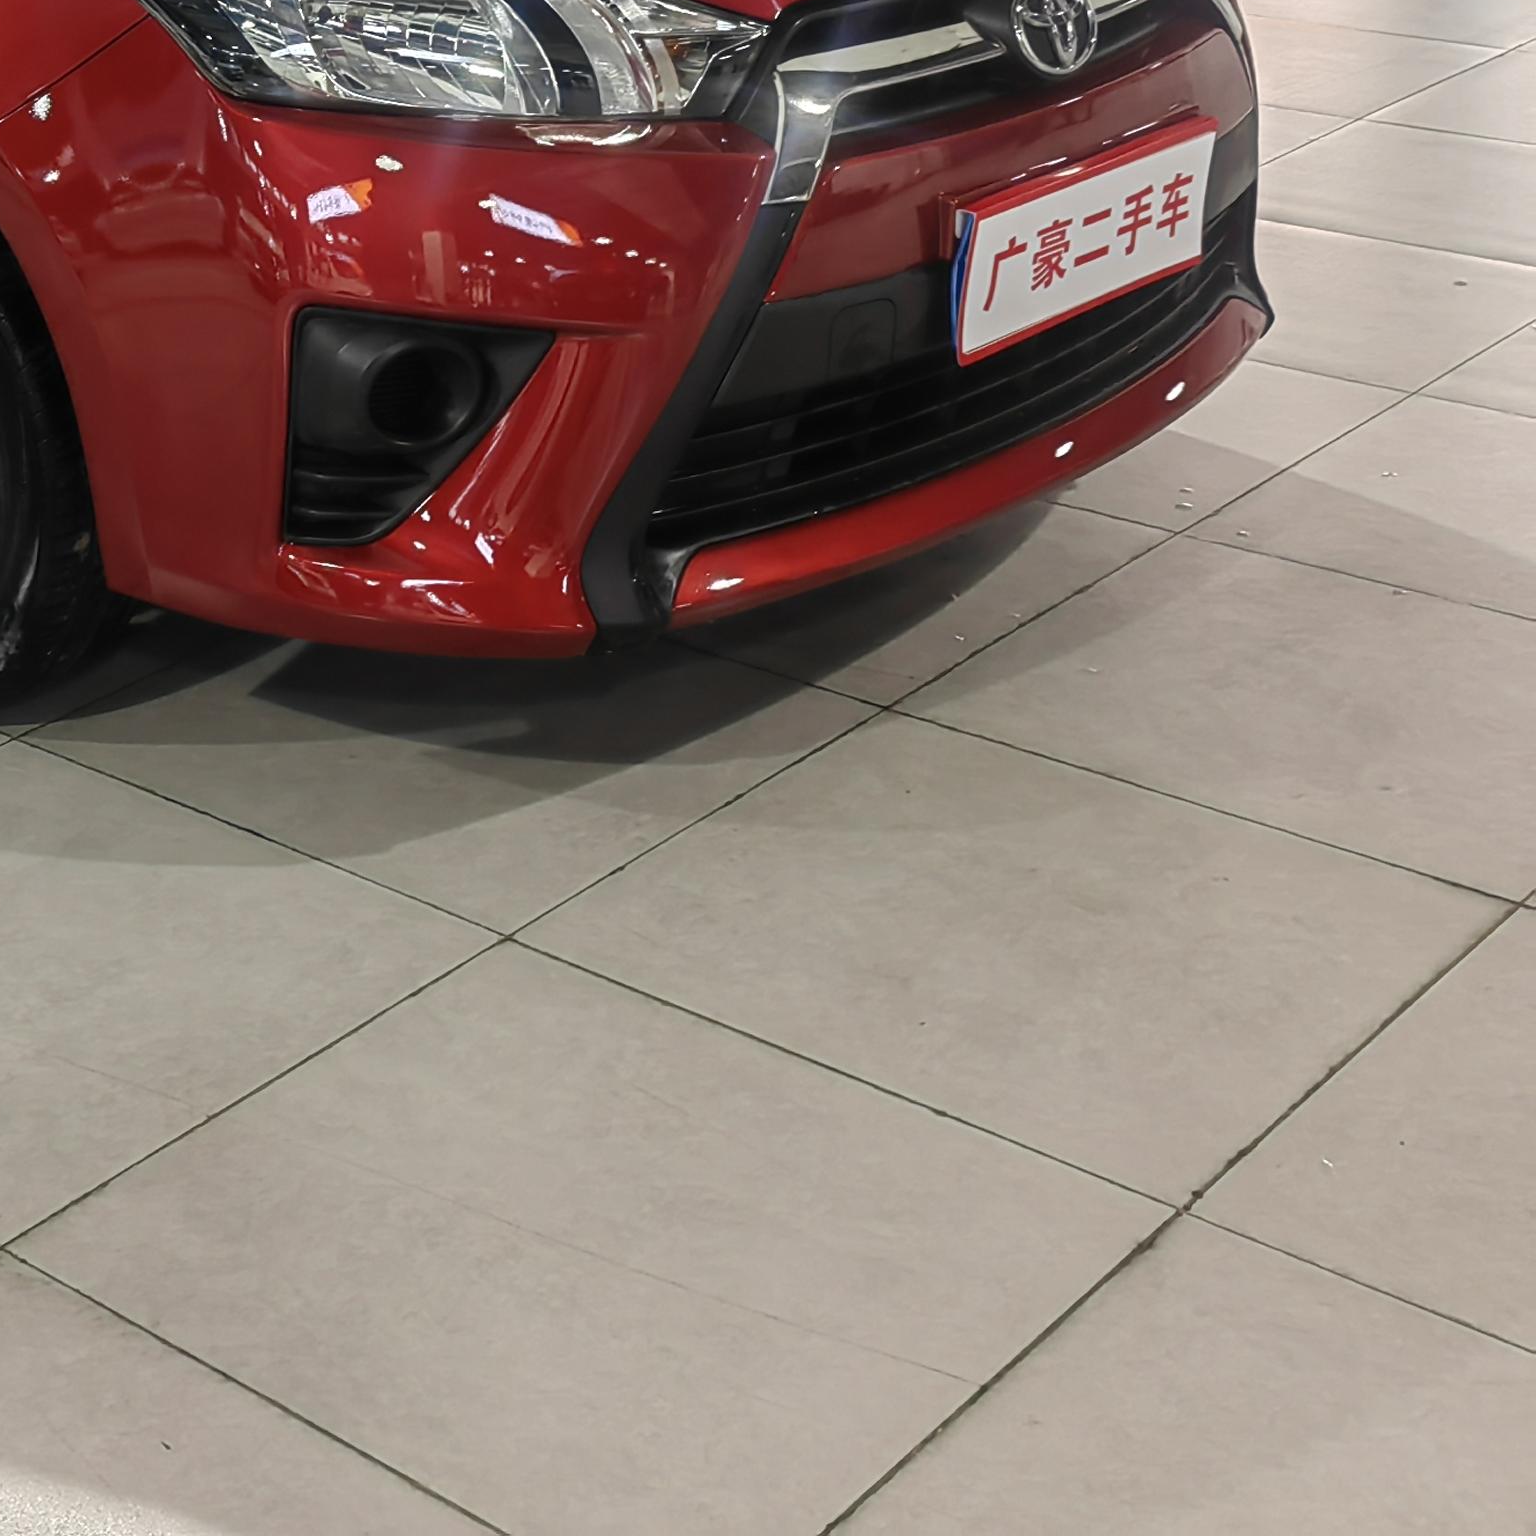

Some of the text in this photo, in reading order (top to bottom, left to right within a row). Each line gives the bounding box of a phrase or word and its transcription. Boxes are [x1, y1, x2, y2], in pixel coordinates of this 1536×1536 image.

[982, 172, 1195, 312] 广豪二手车
